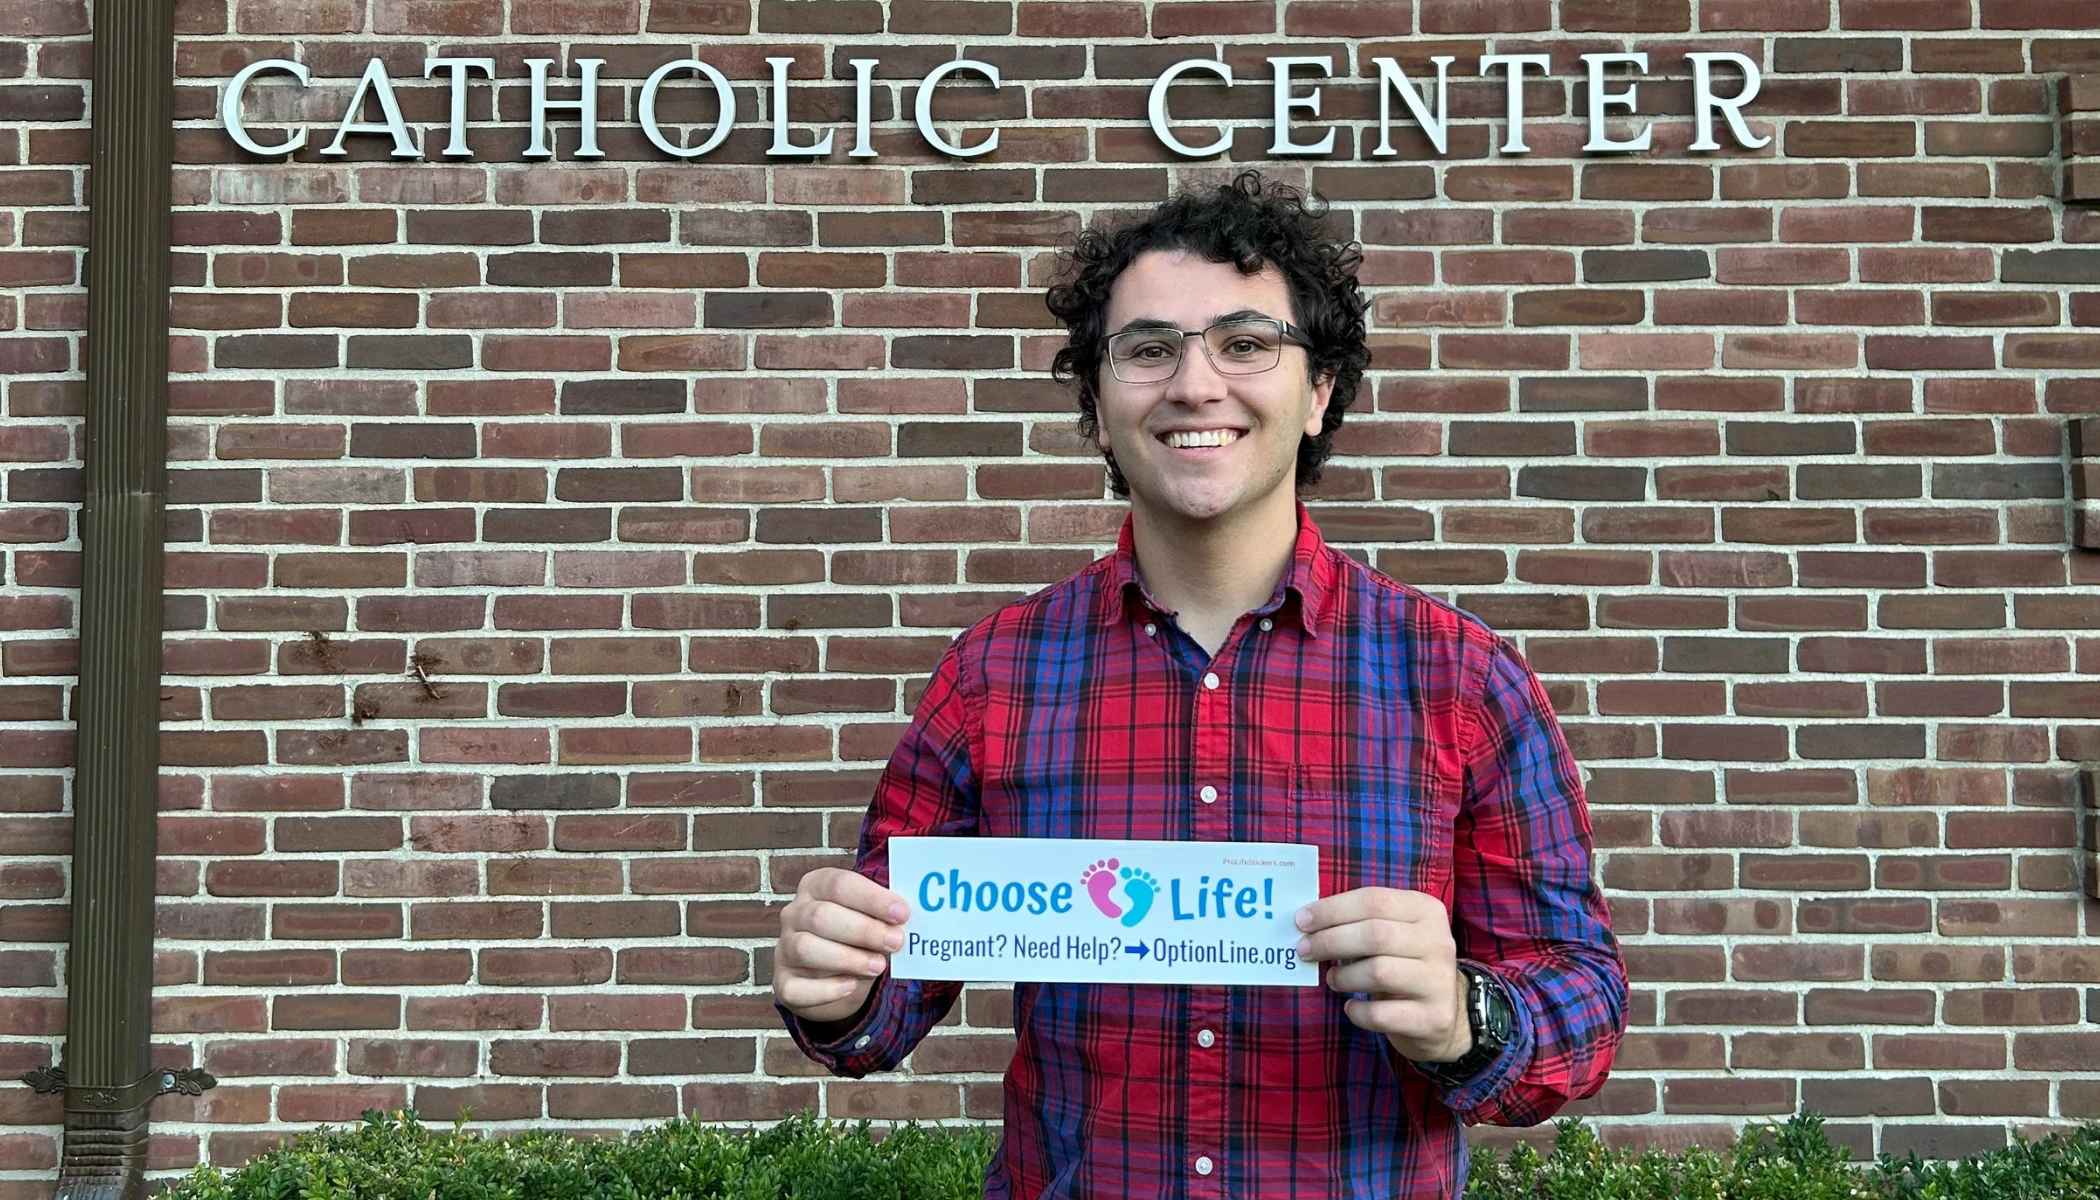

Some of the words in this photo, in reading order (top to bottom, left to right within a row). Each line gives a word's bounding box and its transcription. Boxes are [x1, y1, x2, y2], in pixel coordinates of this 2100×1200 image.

[220, 57, 1001, 159] CATHOLIC
[1148, 52, 1772, 159] CENTER
[1222, 858, 1295, 867] ProLifeStickers.com
[918, 869, 1073, 915] Choose
[1171, 875, 1274, 920] Life!
[908, 933, 1007, 962] Pregnant?
[1014, 935, 1061, 960] Need
[1066, 936, 1122, 965] Help?
[1153, 939, 1298, 970] OptionLine.org
